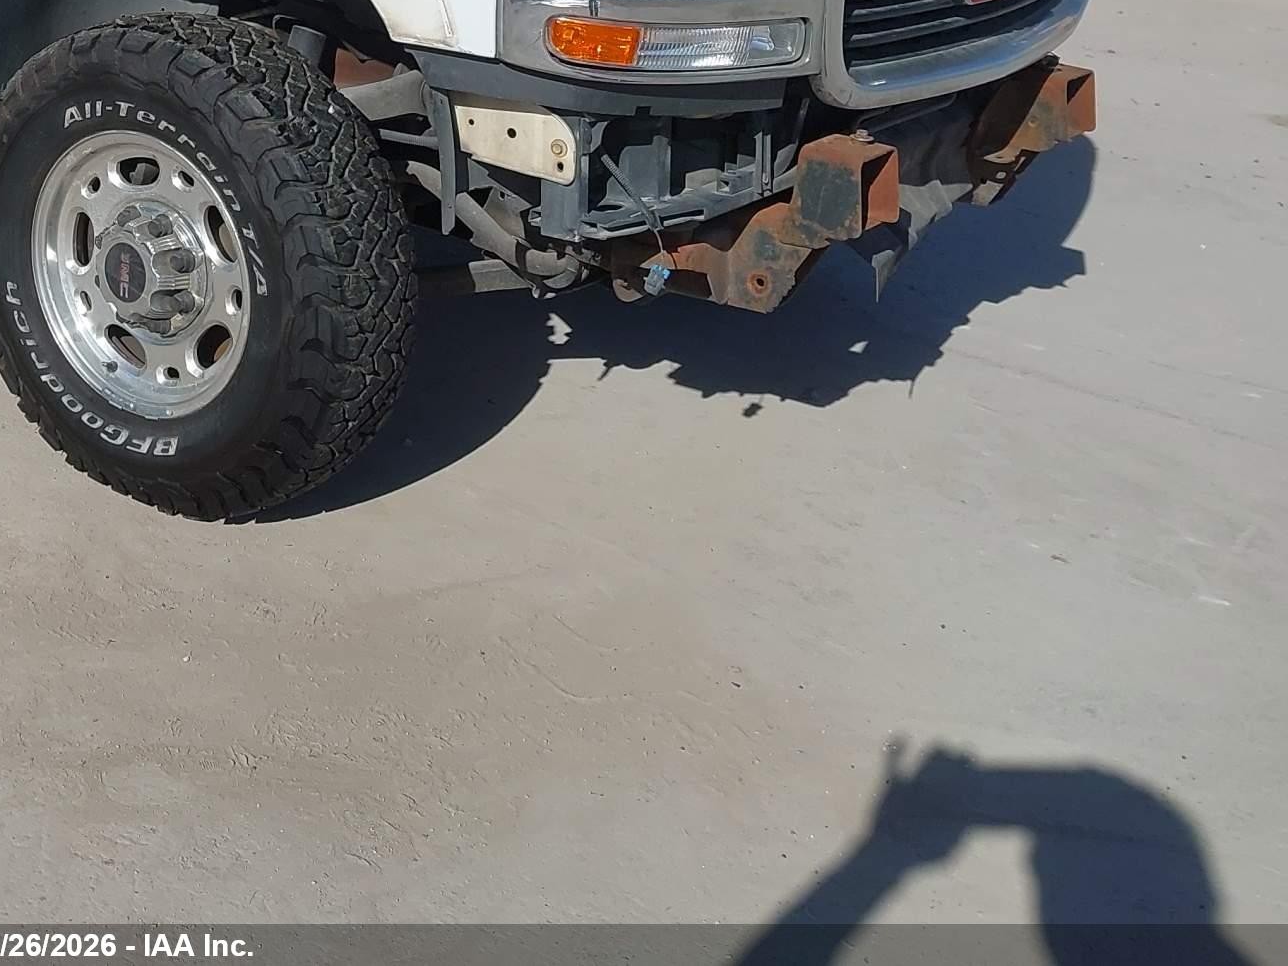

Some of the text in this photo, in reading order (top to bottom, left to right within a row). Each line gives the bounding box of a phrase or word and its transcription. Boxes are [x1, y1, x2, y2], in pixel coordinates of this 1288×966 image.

[64, 100, 241, 212] All-Terrain
[119, 251, 130, 299] GMC
[5, 281, 179, 456] BFGoodrich
